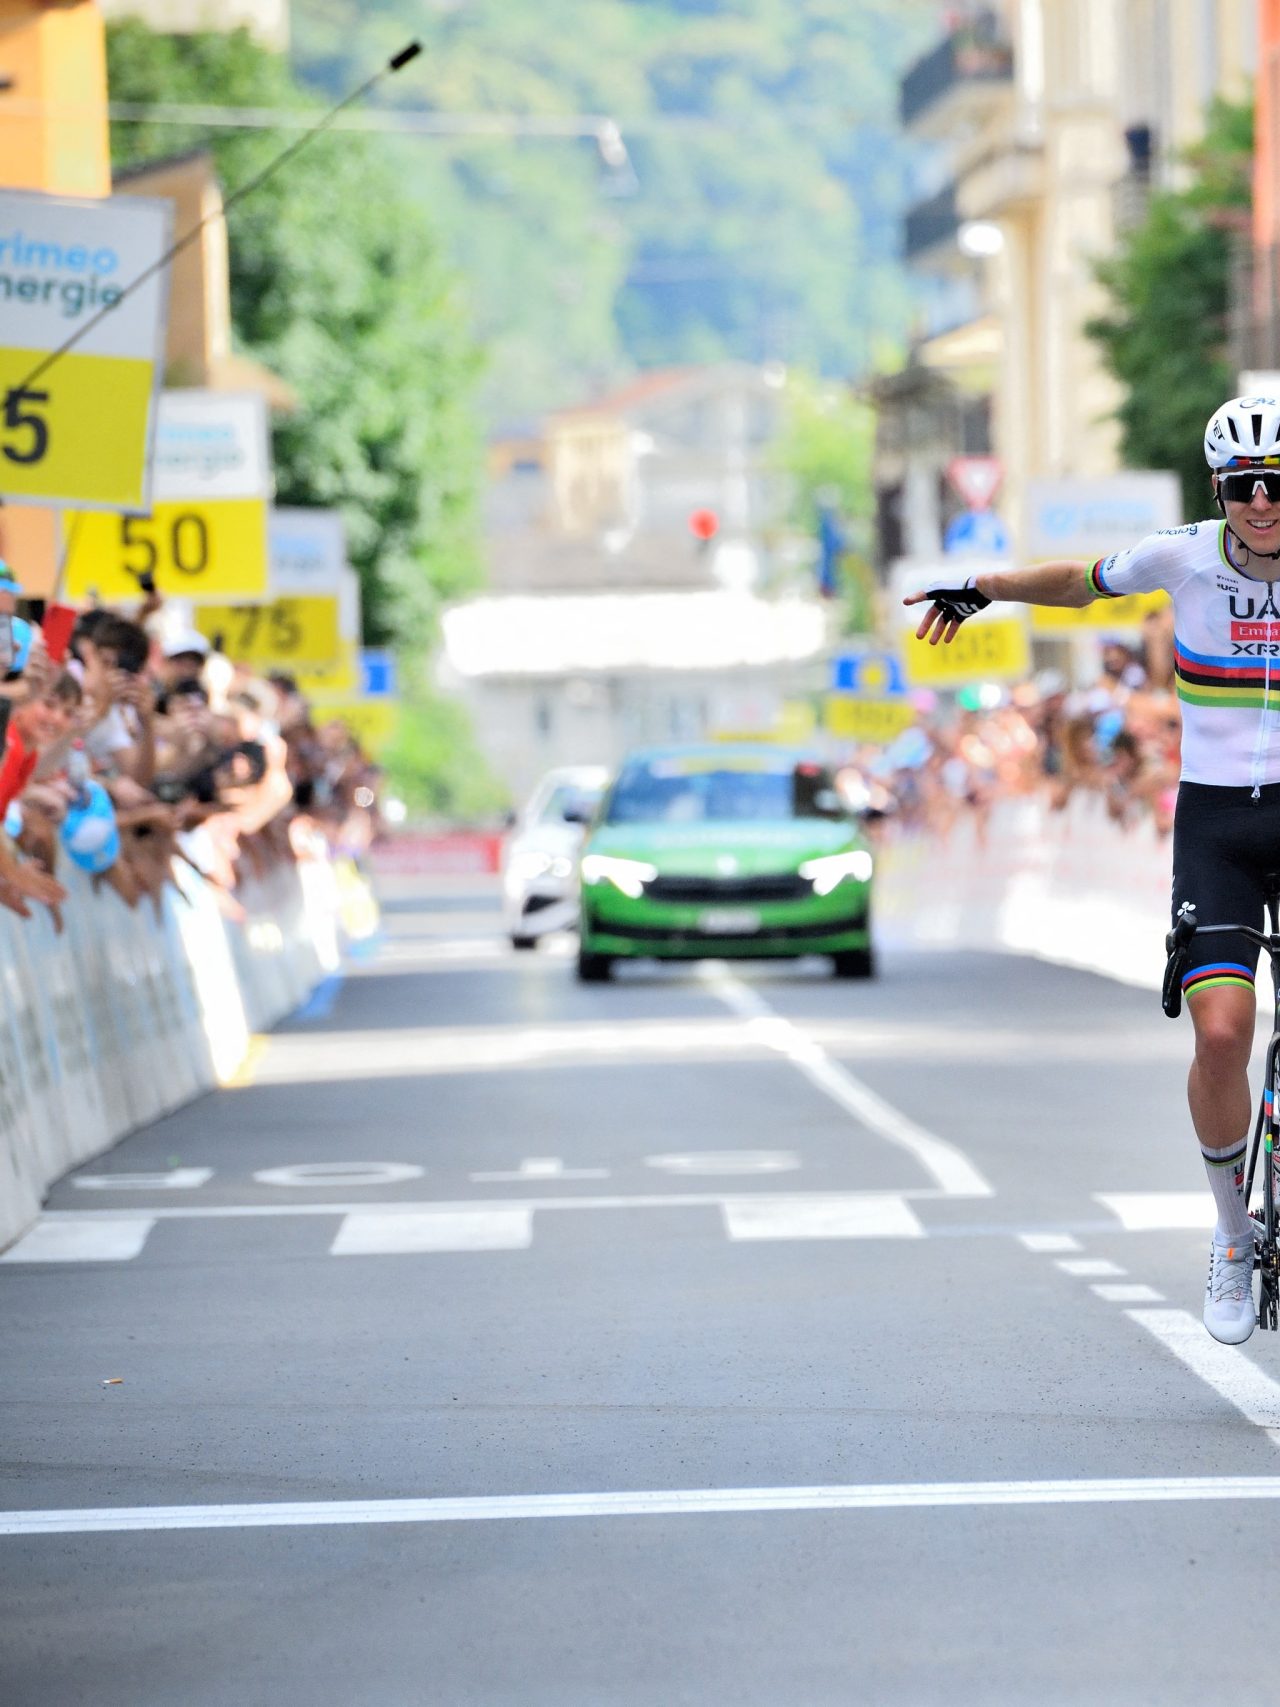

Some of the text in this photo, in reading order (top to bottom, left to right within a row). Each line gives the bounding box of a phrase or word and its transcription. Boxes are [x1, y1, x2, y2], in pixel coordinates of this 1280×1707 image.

[2, 387, 50, 466] 5
[121, 514, 208, 577] 50
[1221, 583, 1239, 594] UCI
[233, 605, 302, 650] 75
